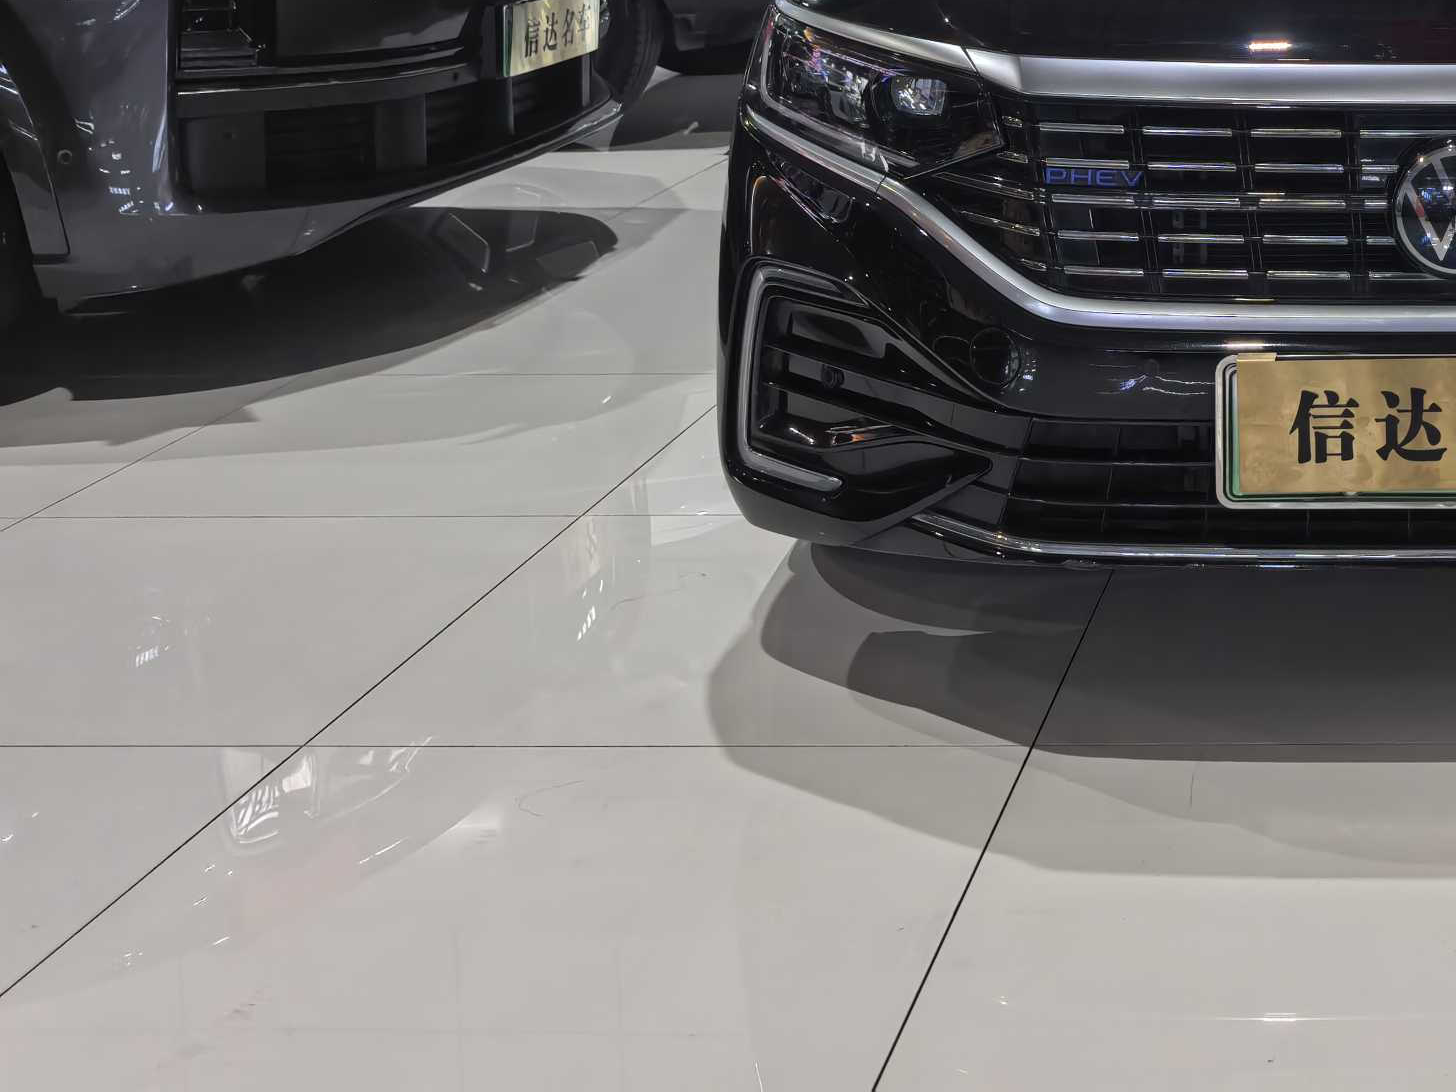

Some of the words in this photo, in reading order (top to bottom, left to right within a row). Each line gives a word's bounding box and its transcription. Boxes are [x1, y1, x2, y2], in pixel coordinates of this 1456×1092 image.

[525, 3, 592, 59] 信达名车
[1045, 168, 1143, 187] PHEV
